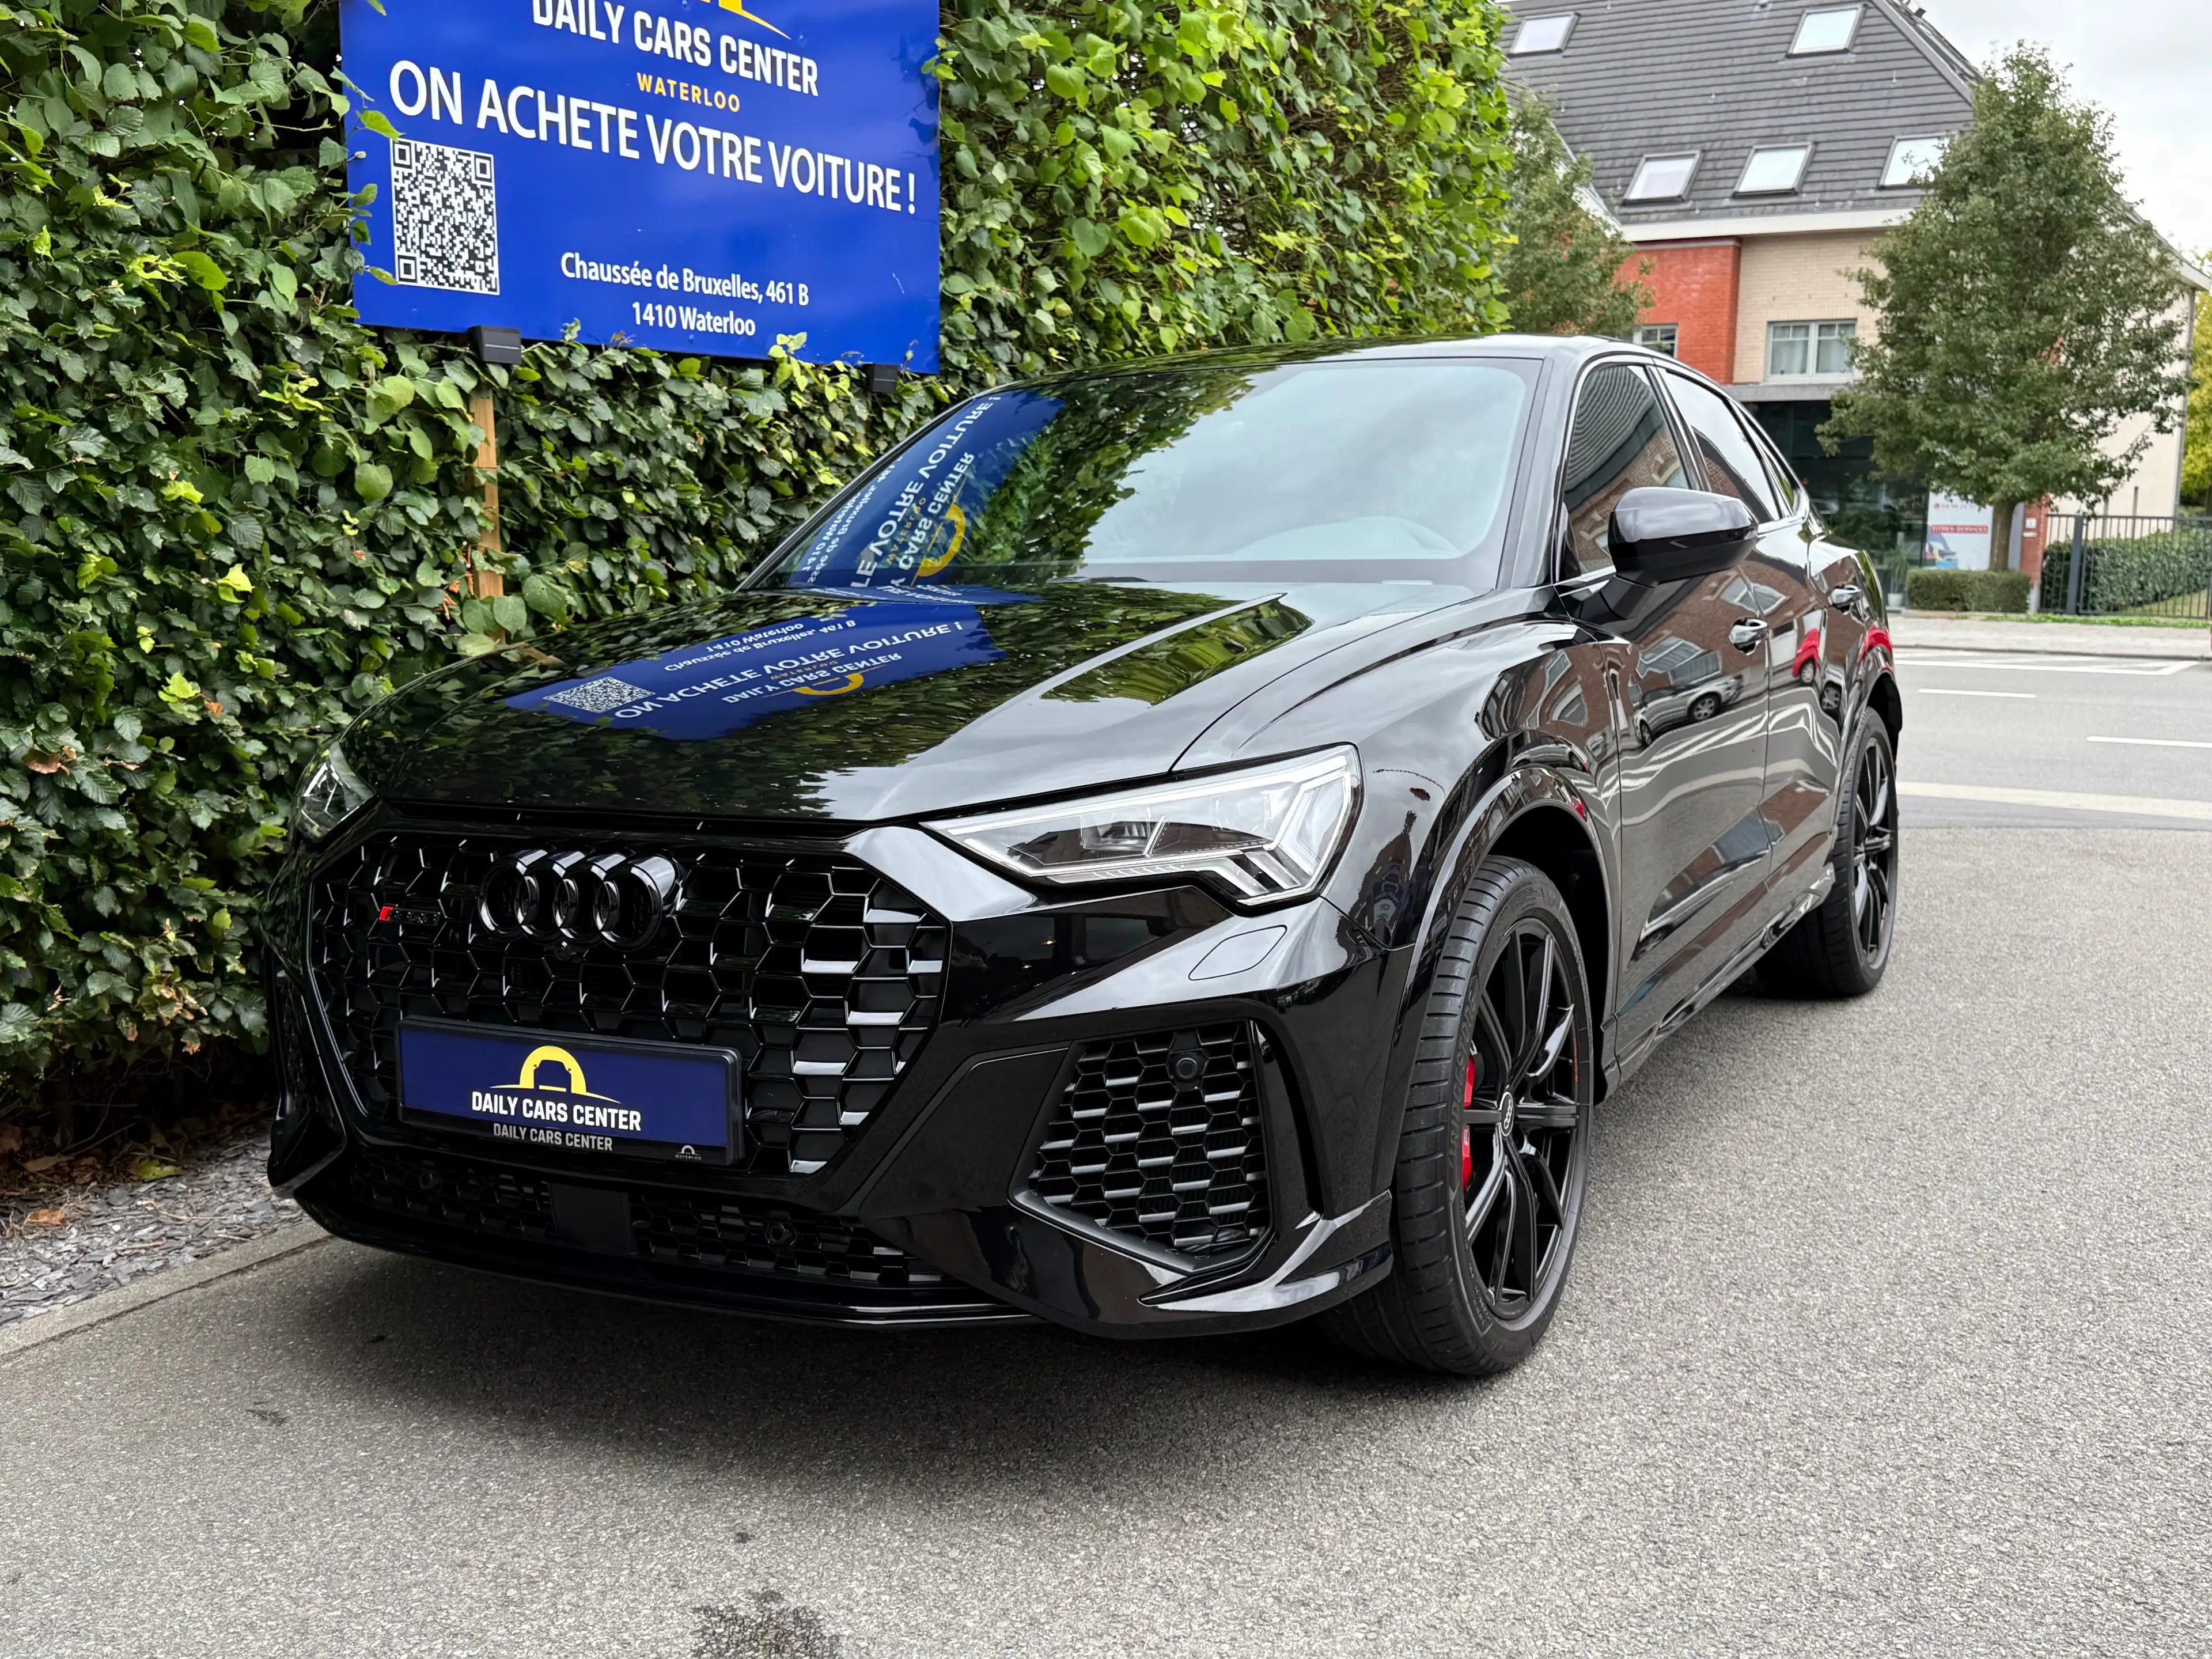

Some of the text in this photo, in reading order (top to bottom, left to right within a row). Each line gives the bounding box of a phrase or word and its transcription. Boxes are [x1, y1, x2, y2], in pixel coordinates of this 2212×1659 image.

[533, 0, 818, 96] DAILY CARS CENTER
[637, 73, 740, 112] WATERLOO
[390, 60, 916, 214] ON ACHETE VOTRE VOITURE !
[561, 252, 809, 306] Chaussée de Bruxelles, 461 B
[632, 302, 756, 336] 1410 Waterloo
[472, 1091, 641, 1131] DAILY CARS CENTER
[494, 1123, 613, 1152] DAILY CARS CENTER
